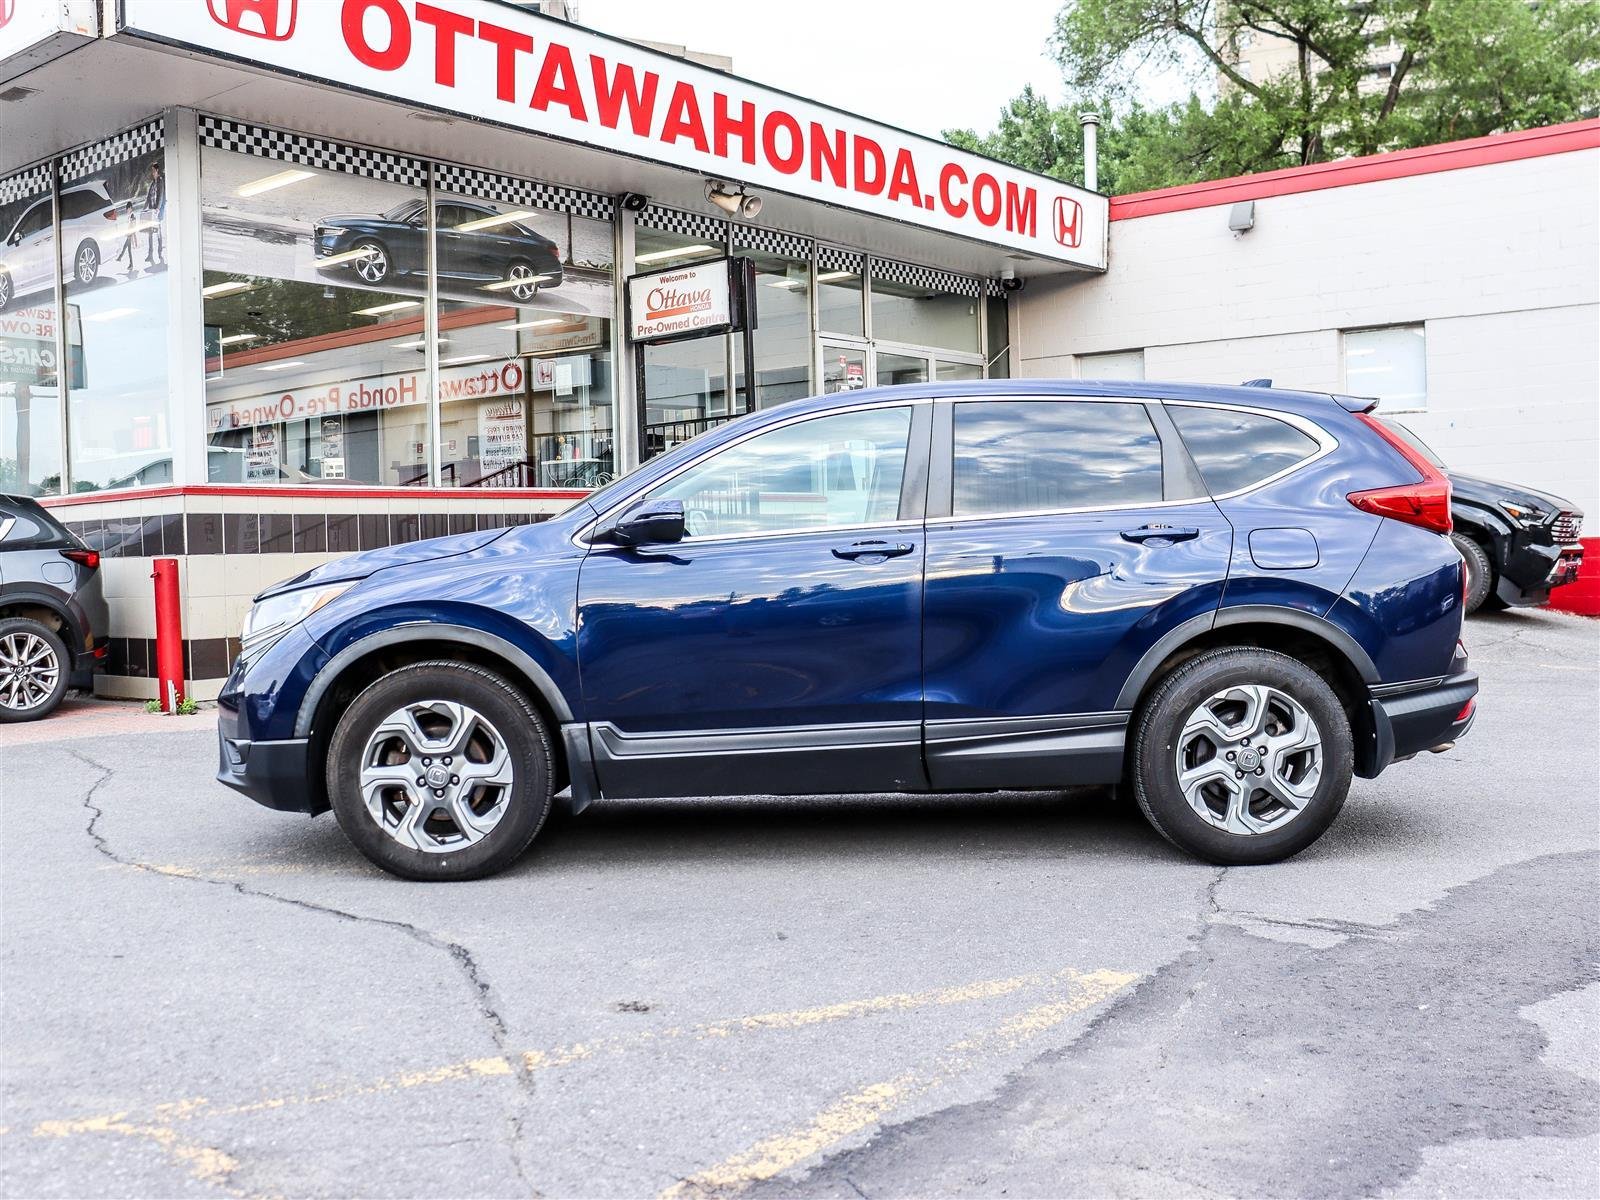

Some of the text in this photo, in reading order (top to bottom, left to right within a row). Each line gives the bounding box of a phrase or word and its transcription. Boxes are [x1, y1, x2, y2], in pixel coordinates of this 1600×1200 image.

[341, 0, 1038, 239] OTTAWAHONDA.COM
[659, 271, 696, 284] Welcome to
[646, 287, 712, 312] Ottawa
[637, 313, 726, 337] Pre-Owned Centre
